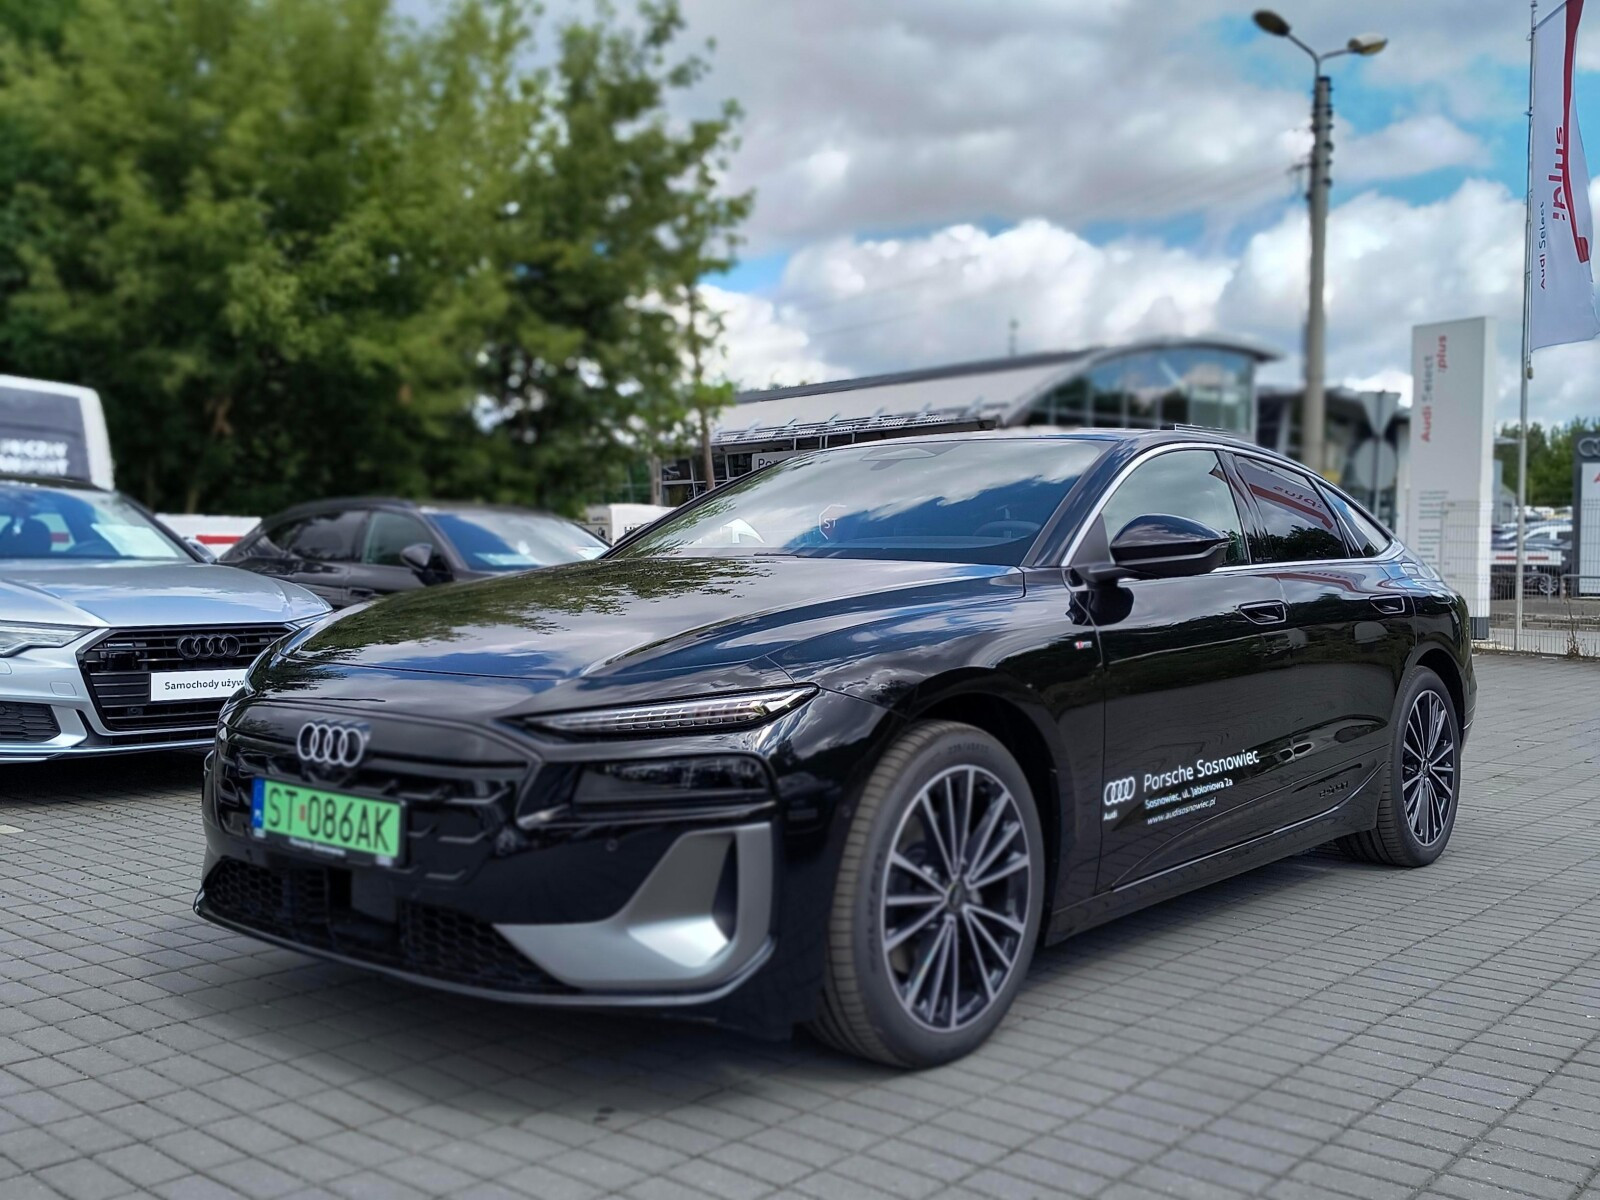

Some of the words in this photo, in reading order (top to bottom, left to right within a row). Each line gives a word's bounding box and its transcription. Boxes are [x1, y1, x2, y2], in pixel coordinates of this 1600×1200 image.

[164, 679, 220, 690] Samochody
[221, 678, 245, 690] używ
[1143, 764, 1194, 793] Porsche
[1196, 749, 1260, 778] Sosnowiec
[1145, 793, 1182, 810] Sosnowiec,
[1182, 789, 1191, 799] ul.
[1224, 777, 1233, 787] 2a
[267, 786, 299, 832] ST
[307, 795, 393, 852] 086AK
[1147, 796, 1217, 825] www.audisosnowiec.pl
